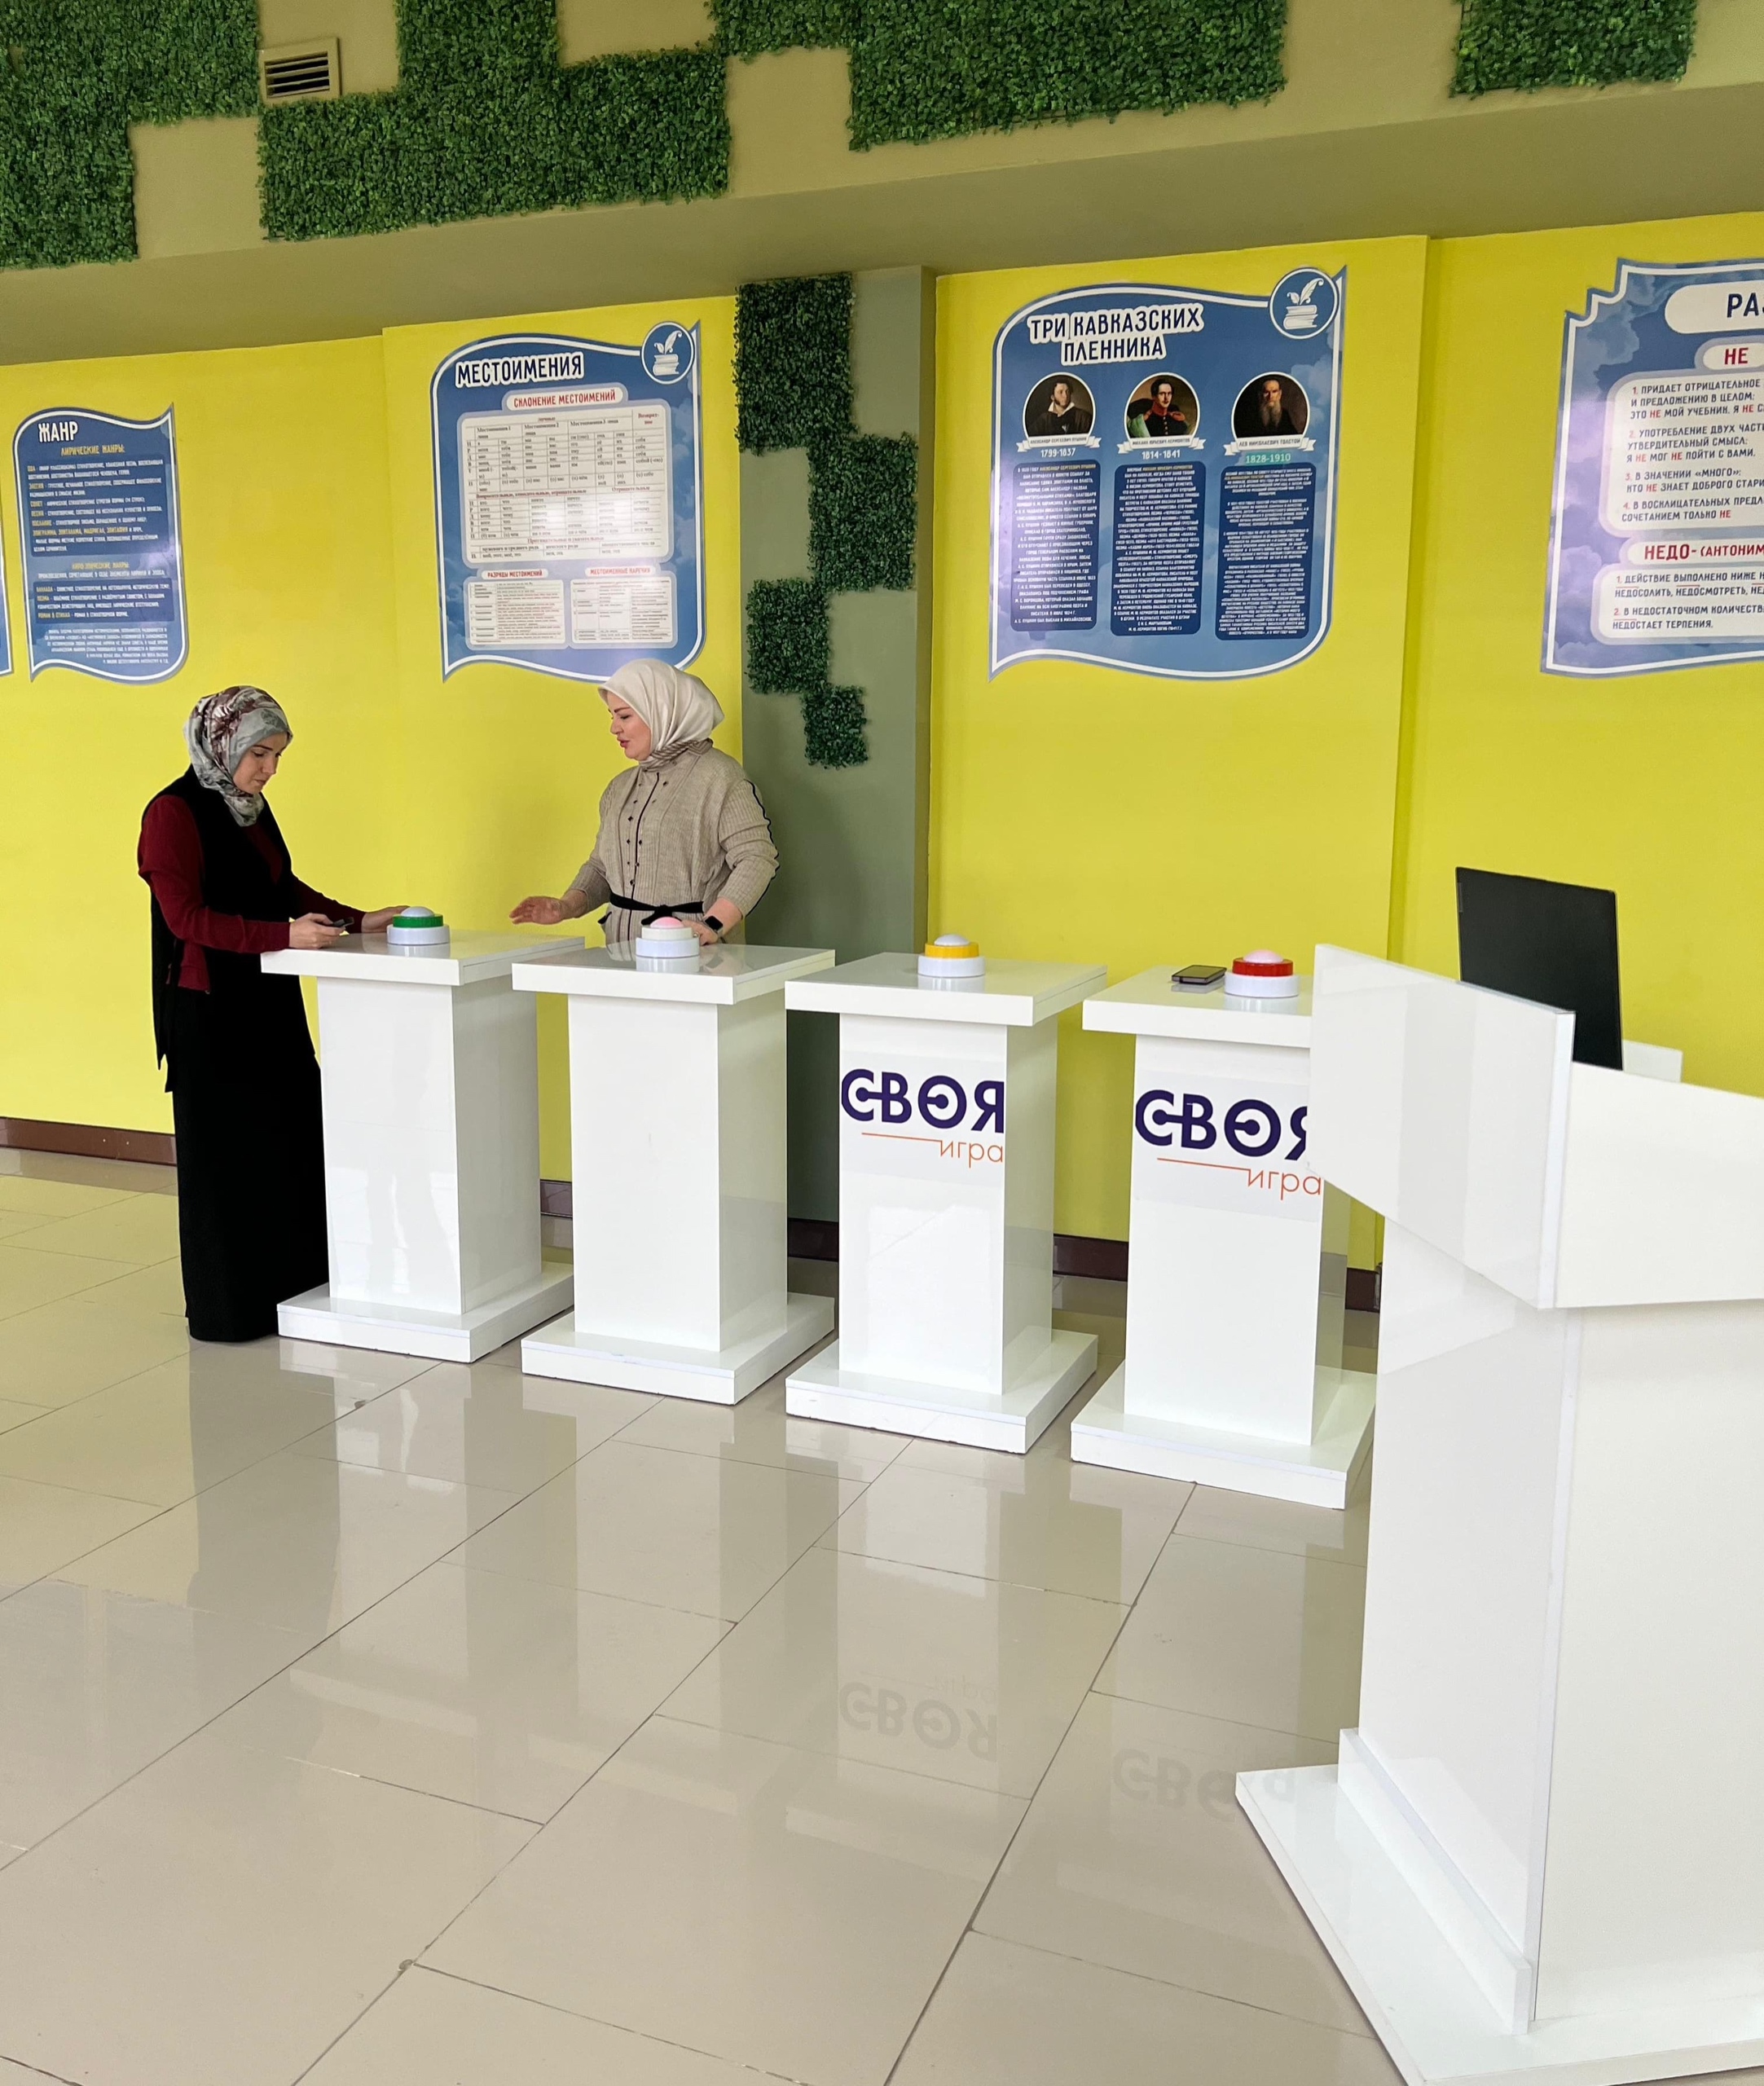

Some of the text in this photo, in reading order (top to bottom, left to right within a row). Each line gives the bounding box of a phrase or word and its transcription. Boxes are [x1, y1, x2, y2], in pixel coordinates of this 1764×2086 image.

[1727, 293, 1764, 318] РА
[1032, 307, 1199, 340] ТРИ КАВКАЗСКИХ
[1064, 337, 1163, 363] ПЛЕННИКА
[1724, 348, 1749, 365] НЕ
[458, 355, 582, 385] МЕСТОИМЕНИЯ
[1642, 384, 1682, 394] ПРИДАЕТ
[1685, 379, 1761, 392] ОТРИЦАТЕЛЬНОЕ
[514, 389, 616, 407] СКЛОНЕНИЕ МЕСТОИМЕНИЙ
[1641, 394, 1708, 407] ПРЕДЛОЖЕНИЮ
[1712, 394, 1717, 402] В
[1721, 392, 1754, 402] ЦЕЛОМ:
[1630, 411, 1647, 419] ЭТО
[1650, 410, 1661, 418] НЕ
[1665, 407, 1683, 417] МОЙ
[1687, 406, 1730, 416] УЧЕБНИК.
[1743, 404, 1754, 413] НЕ
[1757, 403, 1764, 411] С
[38, 421, 78, 442] ЖАНР
[1639, 426, 1707, 438] УПОТРЕБЛЕНИЕ
[1710, 425, 1735, 435] ДВУХ
[1628, 437, 1748, 451] УТВЕРДИТЕЛЬНЫЙ СМЫСЛ:
[1246, 453, 1291, 464] 1828-1910
[1627, 448, 1755, 463] Я НЕ МОГ НЕ ПОЙТИ С ВАМИ.
[1635, 473, 1641, 481] В
[1644, 470, 1691, 481] ЗНАЧЕНИИ
[1627, 484, 1643, 493] КТО
[1646, 484, 1657, 492] НЕ
[1661, 482, 1689, 491] ЗНАЕТ
[1692, 481, 1732, 491] ДОБРОГО
[1643, 498, 1730, 508] ВОСКЛИЦАТЕЛЬНЫХ
[1734, 497, 1764, 506] ПРЕДЛ
[1622, 510, 1731, 522] СОЧЕТАНИЕМ ТОЛЬКО НЕ
[1644, 544, 1697, 561] НЕДО-
[1625, 574, 1670, 583] ДЕЙСТВИЕ
[1674, 573, 1727, 583] ВЫПОЛНЕНО
[1731, 572, 1756, 580] НИЖЕ
[1615, 586, 1764, 598] НЕДОСОЛИТЬ, НЕДОСМОТРЕТЬ, НЕ
[1633, 605, 1708, 615] НЕДОСТАТОЧНОМ
[1712, 605, 1764, 614] КОЛИЧЕСТВ
[1613, 620, 1713, 630] НЕДОСТАЕТ ТЕРПЕНИЯ.
[842, 1068, 1005, 1133] СВОЯ
[940, 1141, 1003, 1168] игра
[1248, 1169, 1321, 1200] игра
